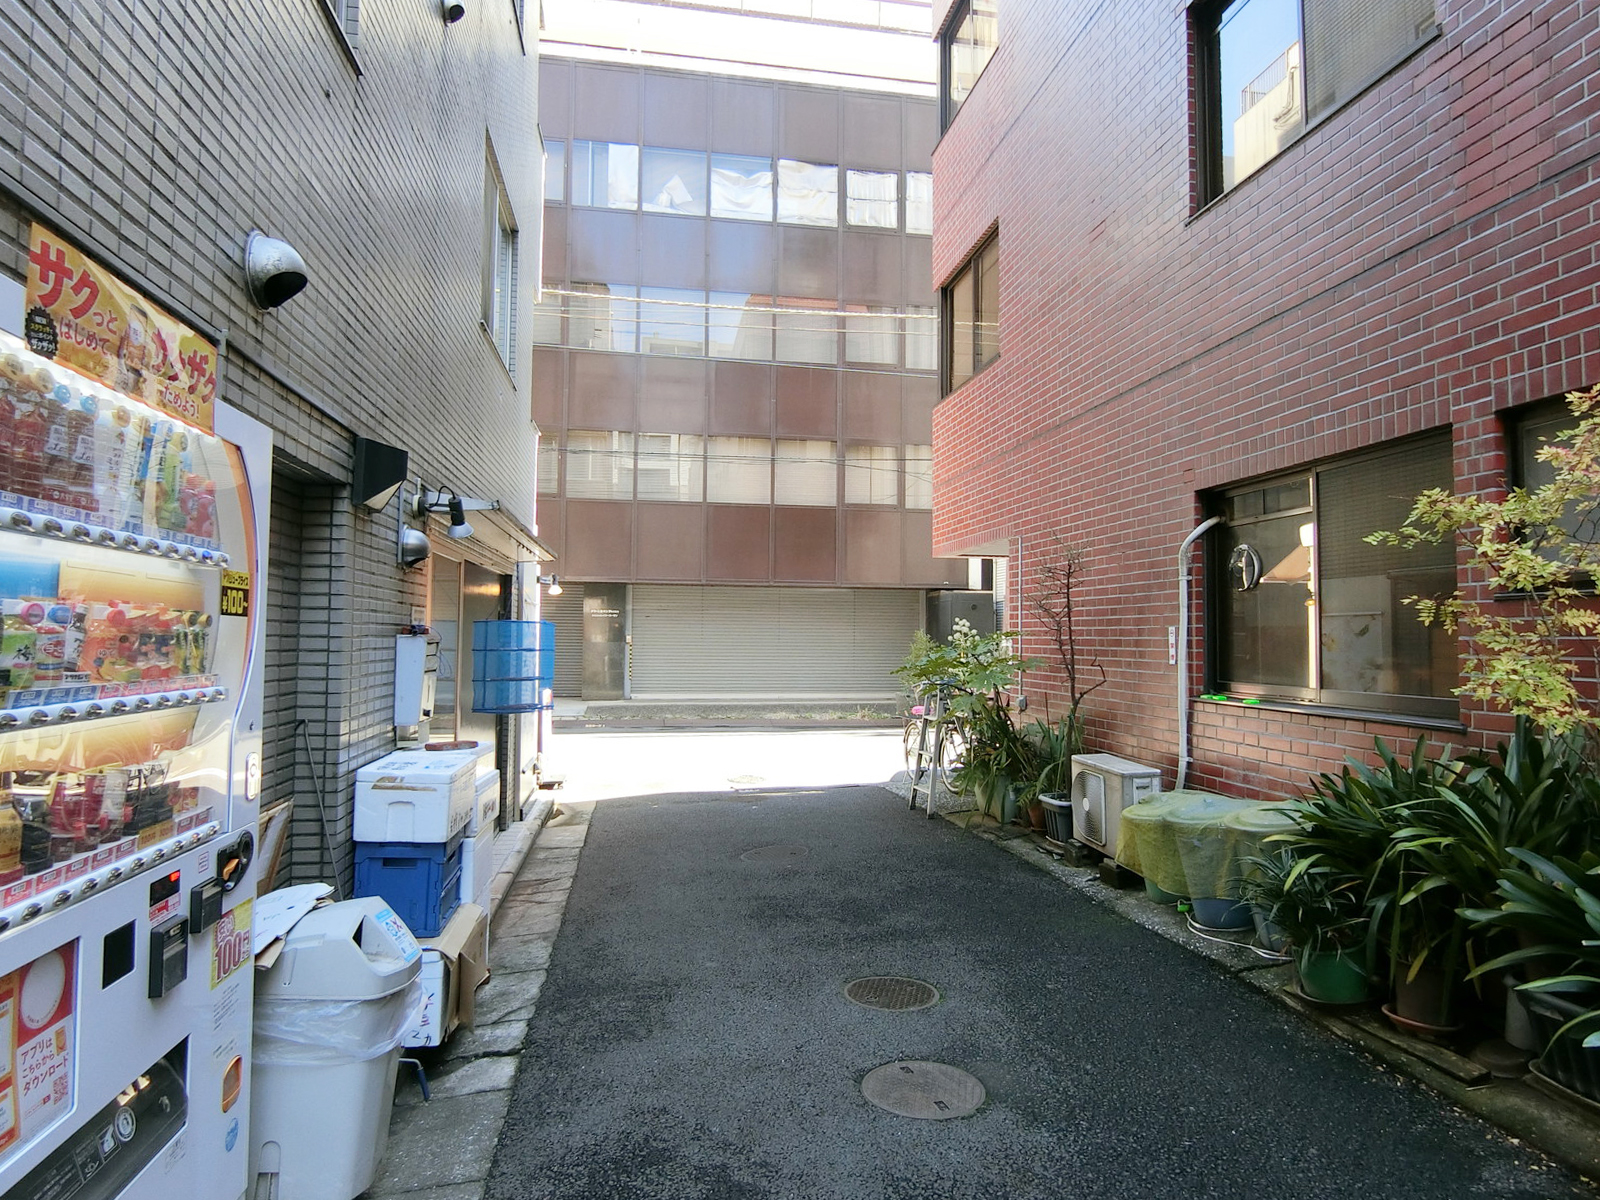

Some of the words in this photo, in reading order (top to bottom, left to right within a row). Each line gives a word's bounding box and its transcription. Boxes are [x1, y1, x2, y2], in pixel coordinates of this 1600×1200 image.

[59, 317, 109, 355] はじめて
[21, 1037, 53, 1065] アプリは
[22, 1050, 55, 1079] こちらから
[23, 1051, 69, 1097] ダウンロード
